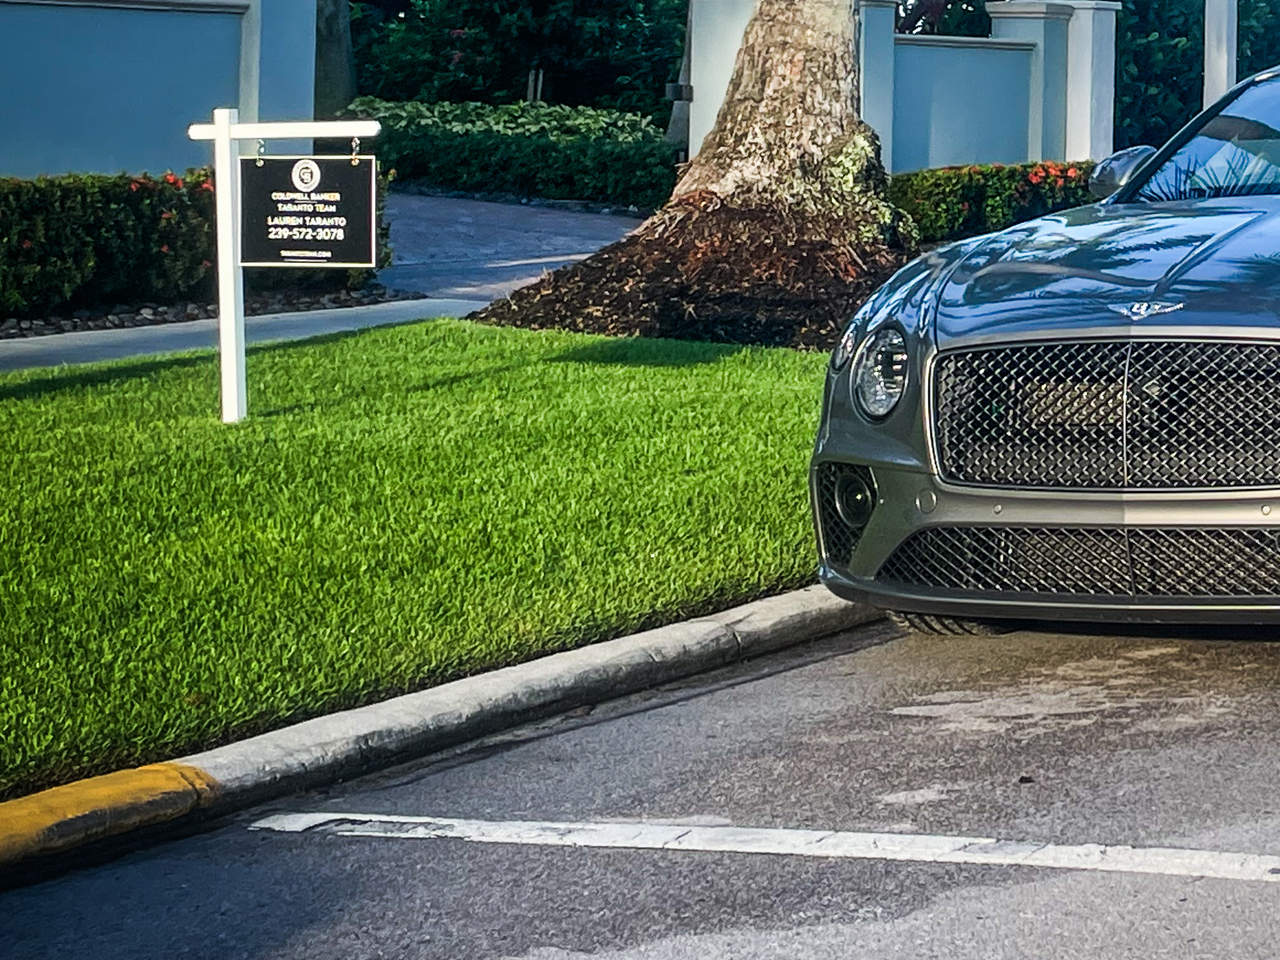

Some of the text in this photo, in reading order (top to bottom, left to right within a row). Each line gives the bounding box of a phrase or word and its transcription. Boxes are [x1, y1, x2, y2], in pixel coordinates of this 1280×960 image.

[310, 192, 340, 201] BANKER
[277, 203, 336, 212] TARANTO TEAM
[267, 216, 346, 226] LAUREN TARANTO
[268, 227, 344, 240] 239-572-3078
